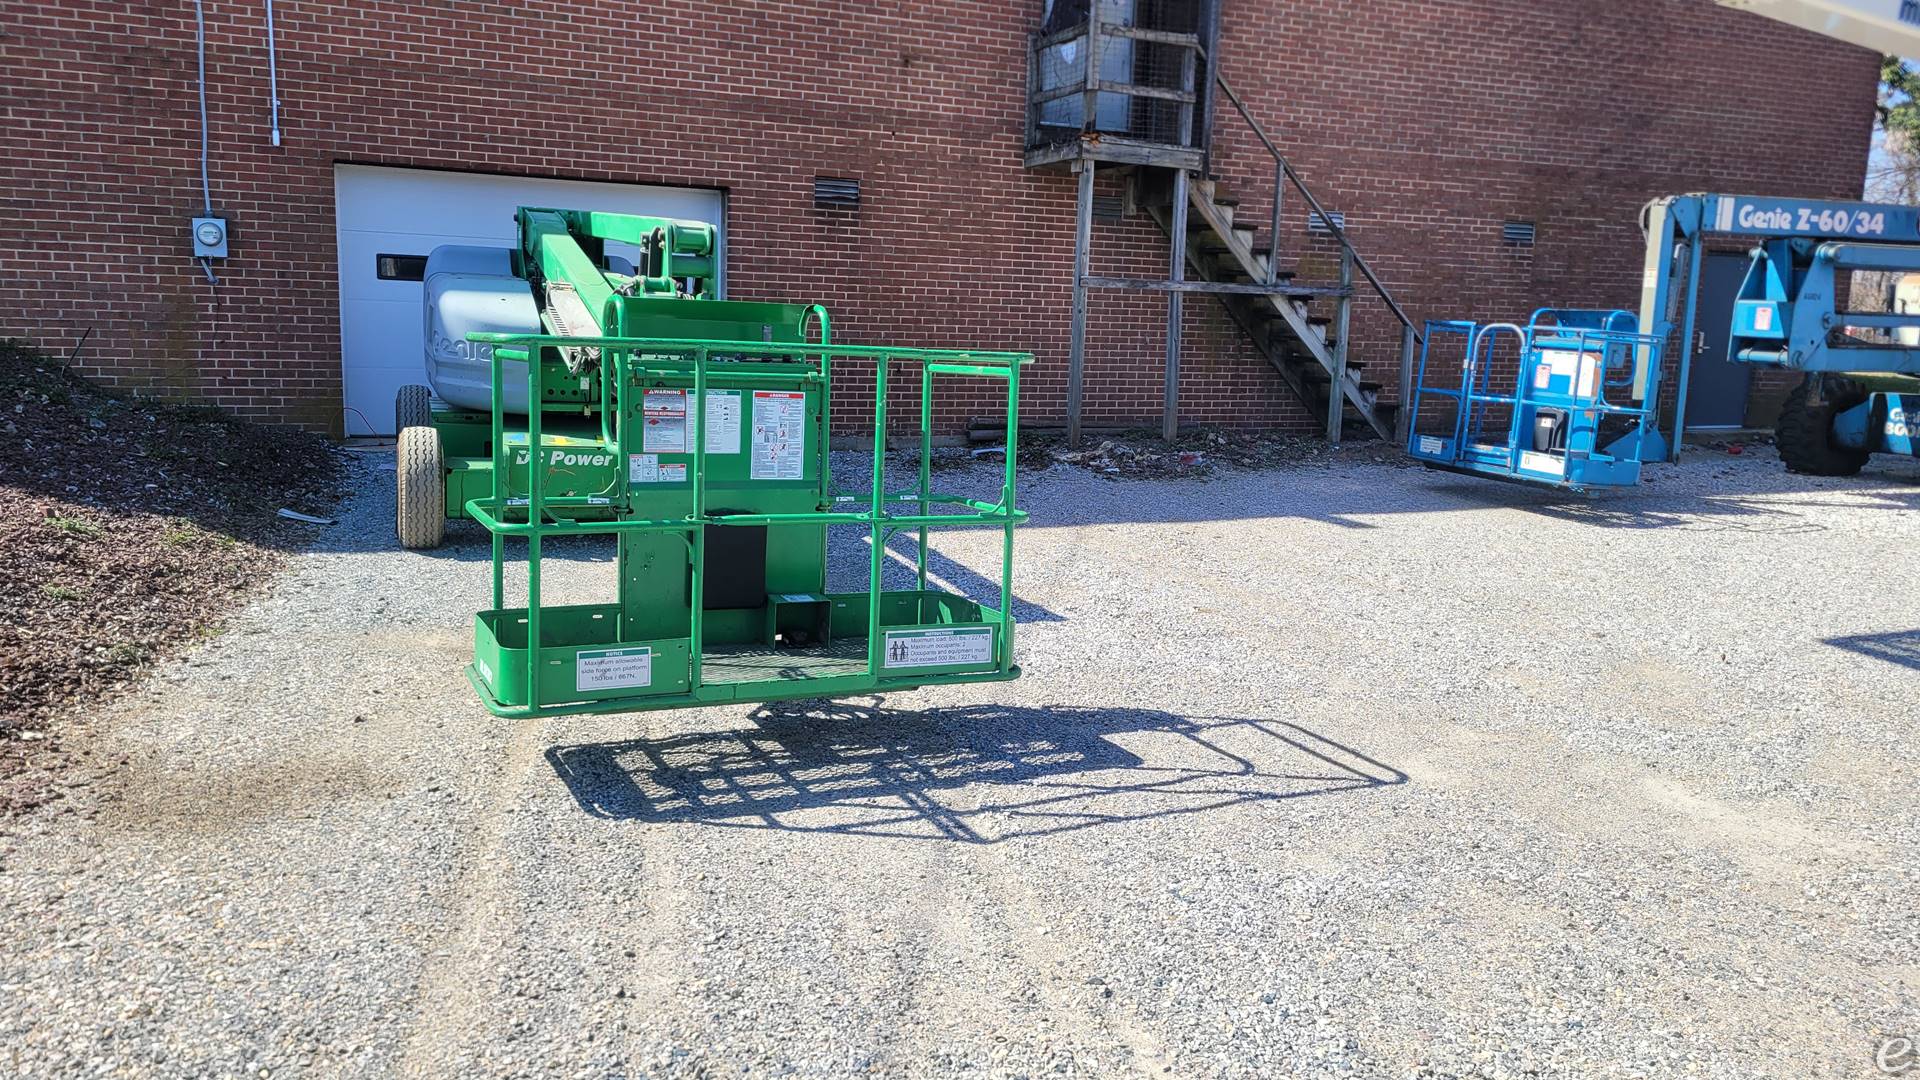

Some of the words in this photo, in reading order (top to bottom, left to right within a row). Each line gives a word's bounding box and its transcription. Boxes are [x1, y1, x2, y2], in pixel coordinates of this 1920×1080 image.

[1738, 204, 1793, 230] Genie
[1795, 208, 1885, 235] Z-60/34
[550, 450, 613, 466] Power
[622, 664, 648, 672] platform
